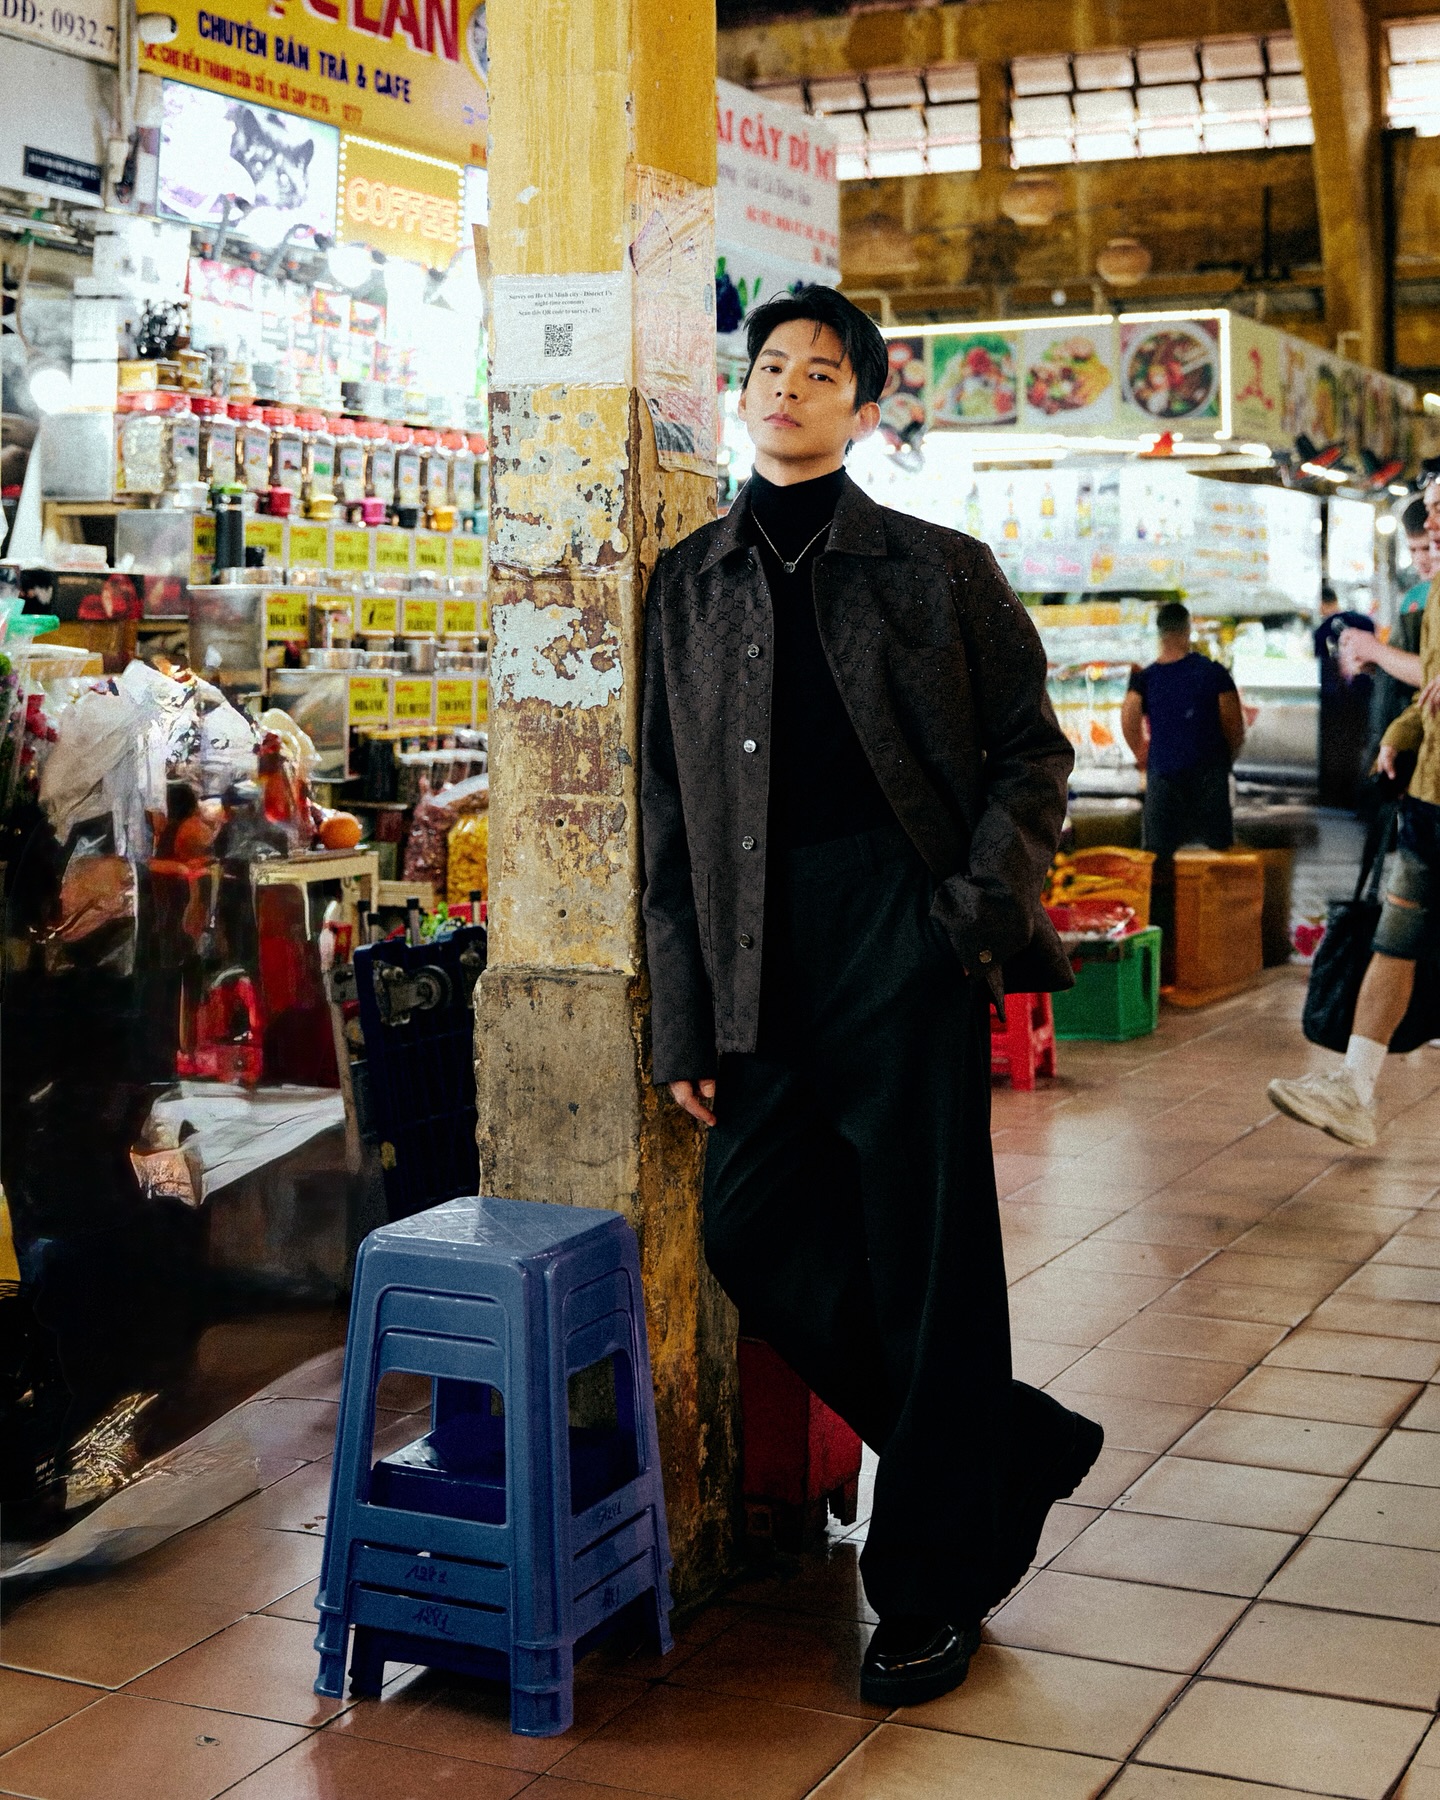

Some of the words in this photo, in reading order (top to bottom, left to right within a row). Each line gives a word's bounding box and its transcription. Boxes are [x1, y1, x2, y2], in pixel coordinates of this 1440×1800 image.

[198, 10, 267, 58] CHUYÊN
[356, 63, 367, 89] &
[346, 177, 458, 243] COFFEE
